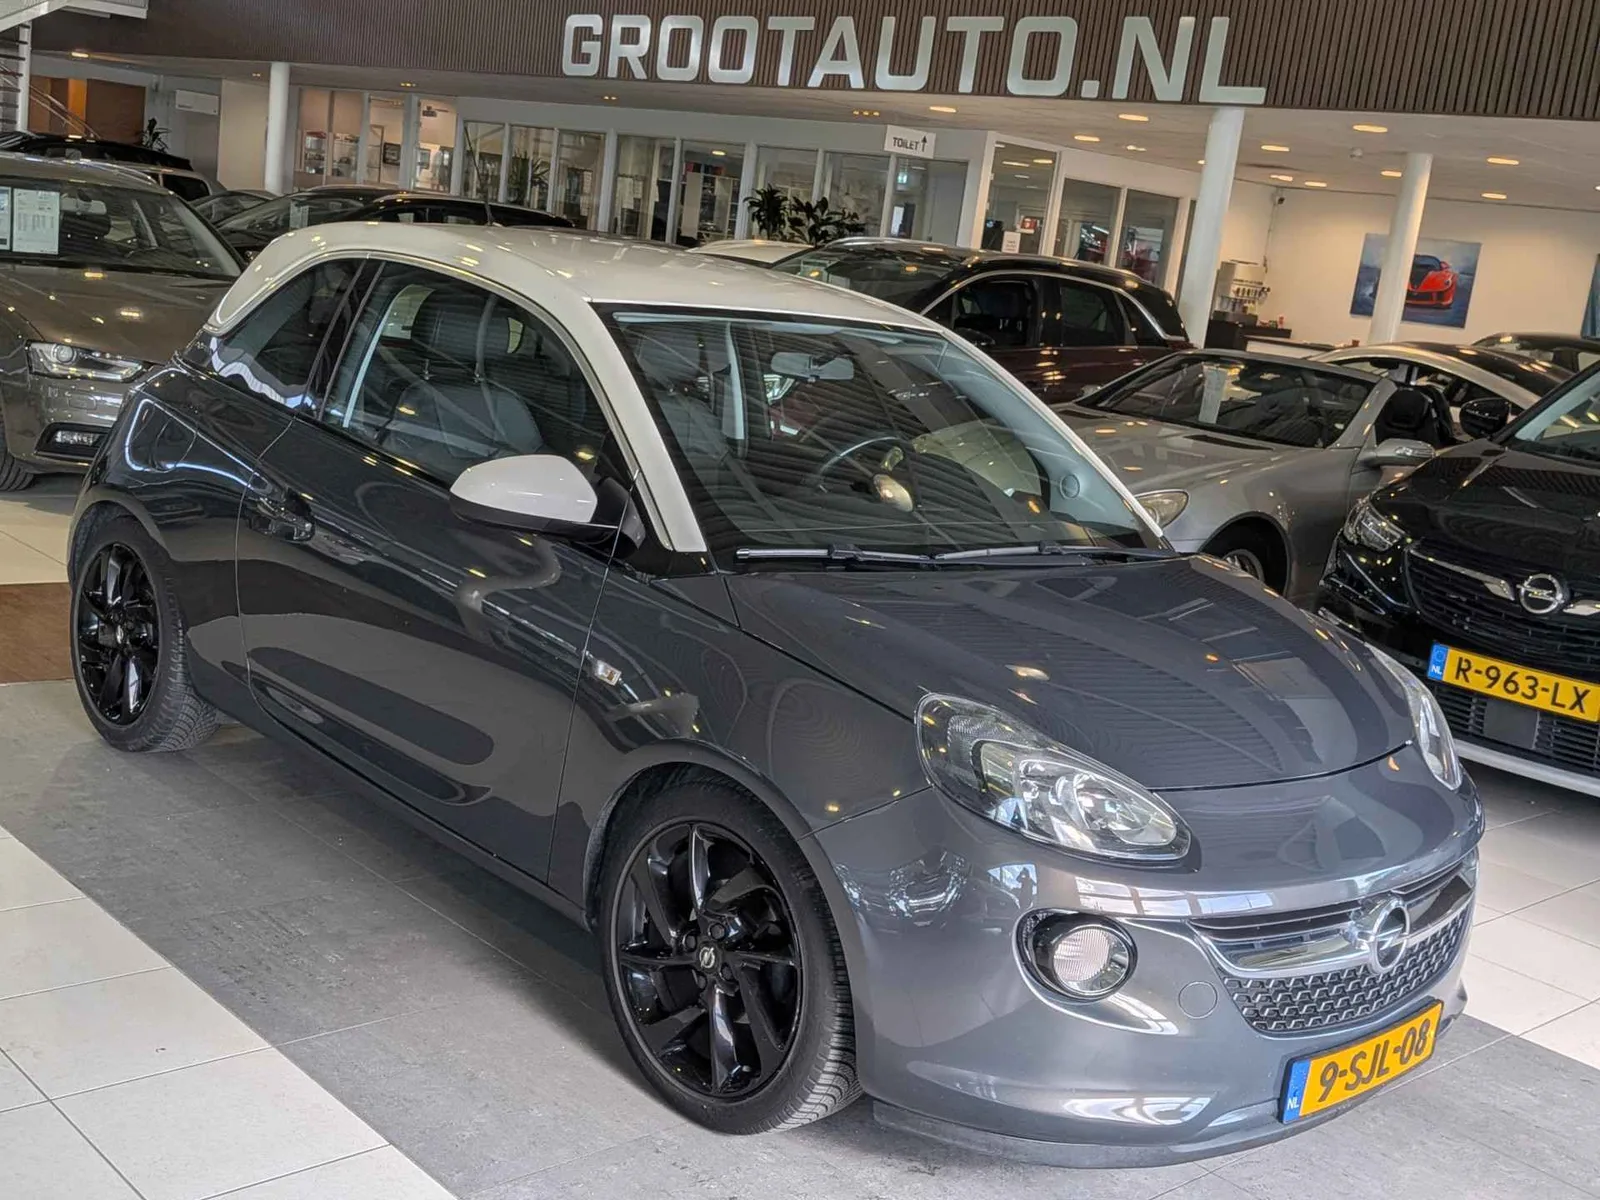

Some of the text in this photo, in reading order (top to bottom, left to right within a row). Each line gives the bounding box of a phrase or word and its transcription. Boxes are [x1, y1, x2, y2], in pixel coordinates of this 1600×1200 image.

[563, 15, 1266, 104] GROOTAUTO.NL
[1431, 657, 1591, 713] NL R-963-LX
[1287, 1018, 1431, 1110] NL 9-SJL-08
